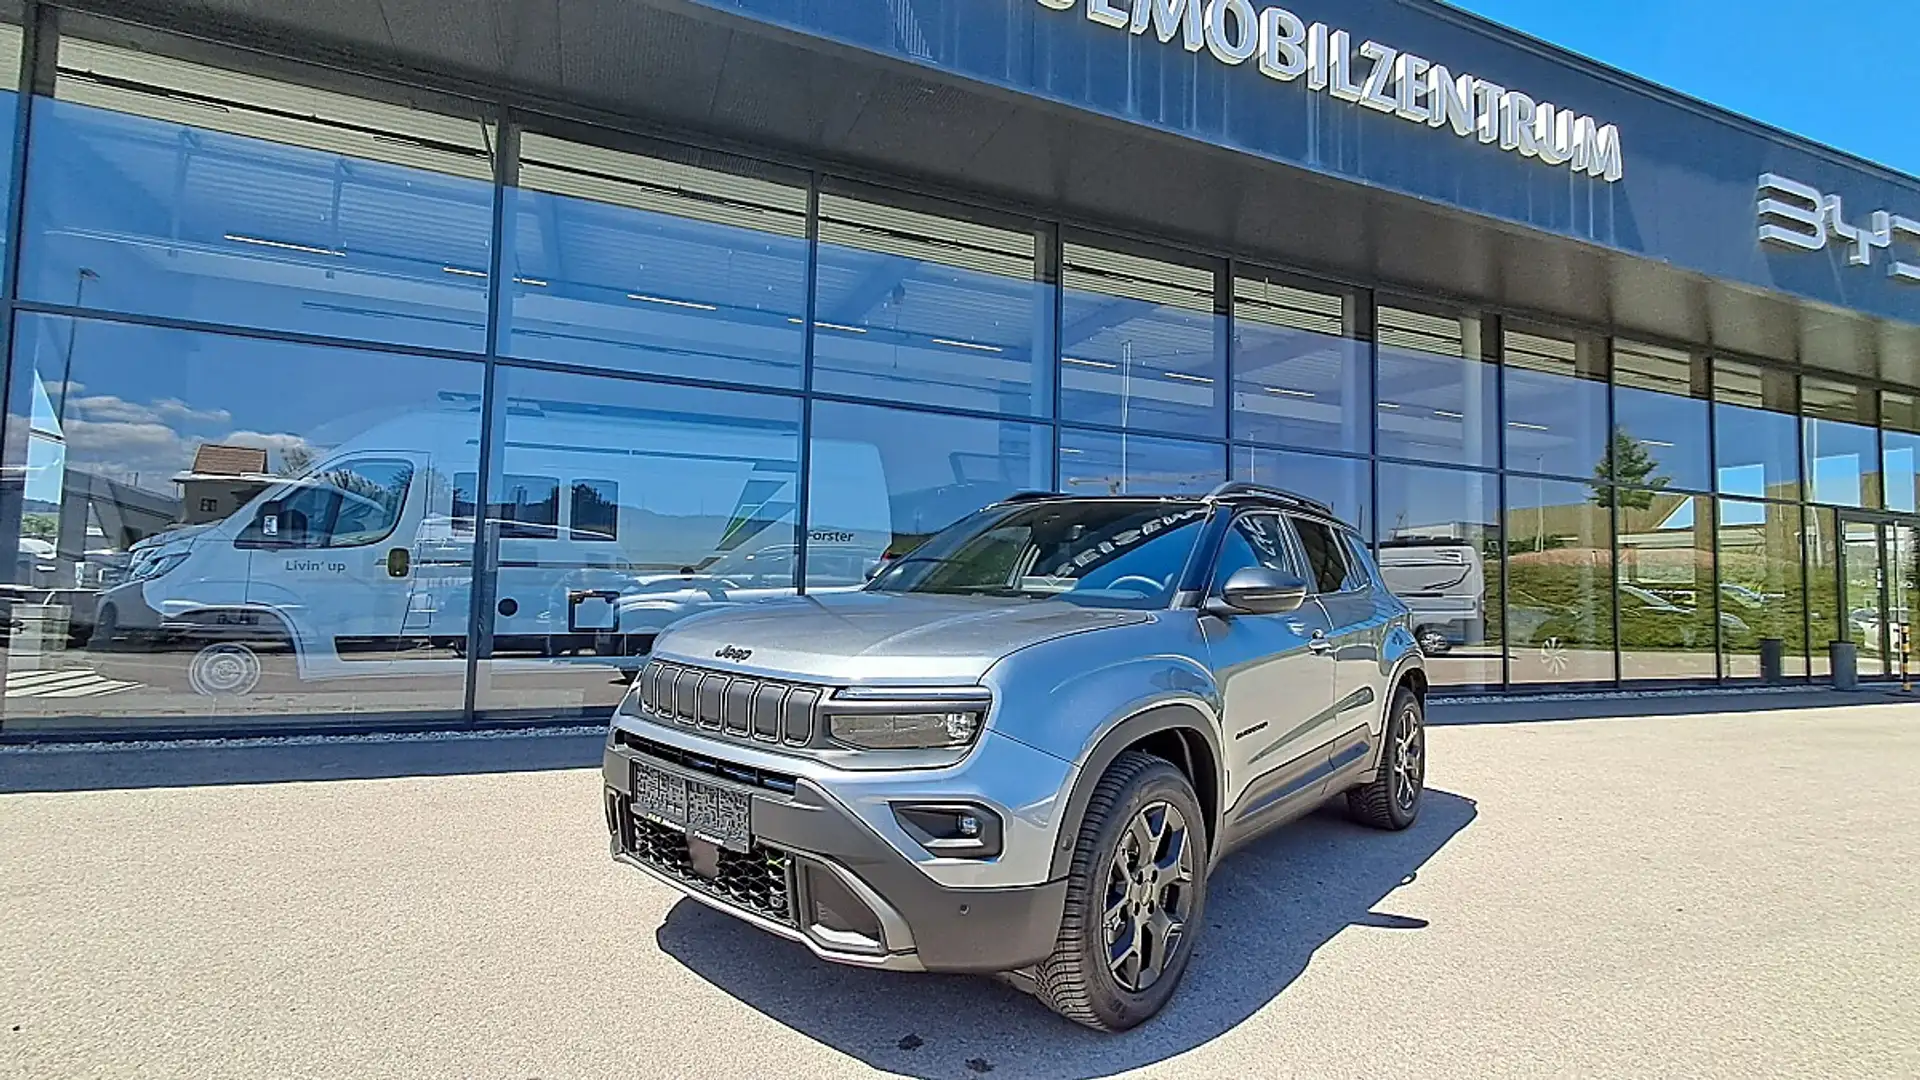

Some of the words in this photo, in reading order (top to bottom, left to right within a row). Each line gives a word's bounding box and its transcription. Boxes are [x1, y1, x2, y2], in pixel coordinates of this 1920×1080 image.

[1036, 0, 1623, 182] MOBILZENTRUM
[328, 563, 346, 574] up
[715, 644, 752, 663] Jeep
